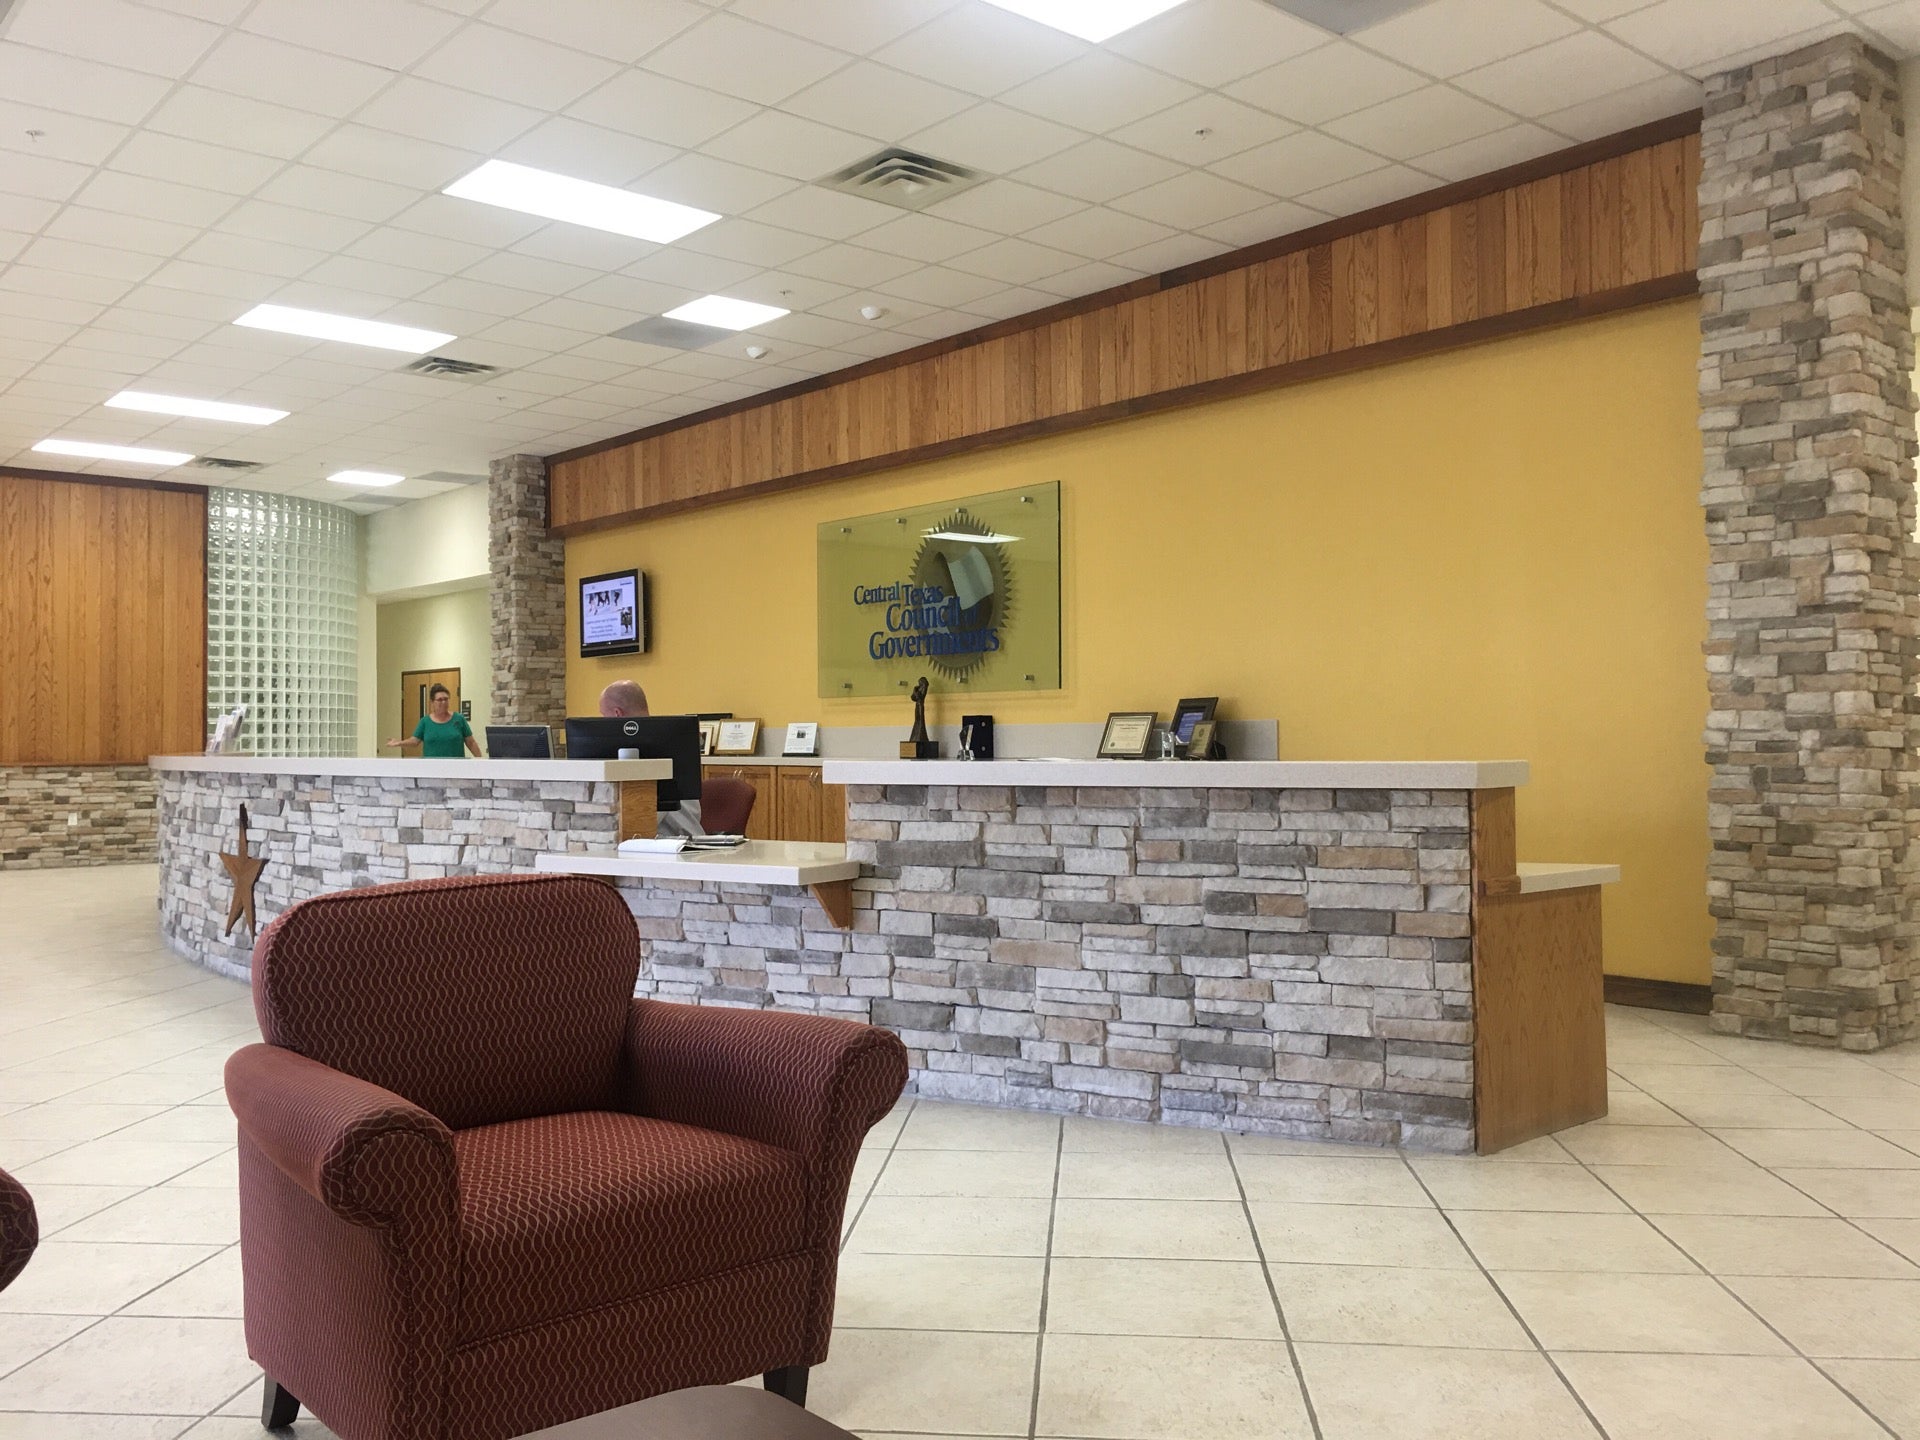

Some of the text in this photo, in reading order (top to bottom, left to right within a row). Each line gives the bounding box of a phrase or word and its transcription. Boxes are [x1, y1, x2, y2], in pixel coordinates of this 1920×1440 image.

[854, 581, 944, 606] Central Texas
[886, 597, 960, 632] Council
[869, 627, 1000, 660] Governments
